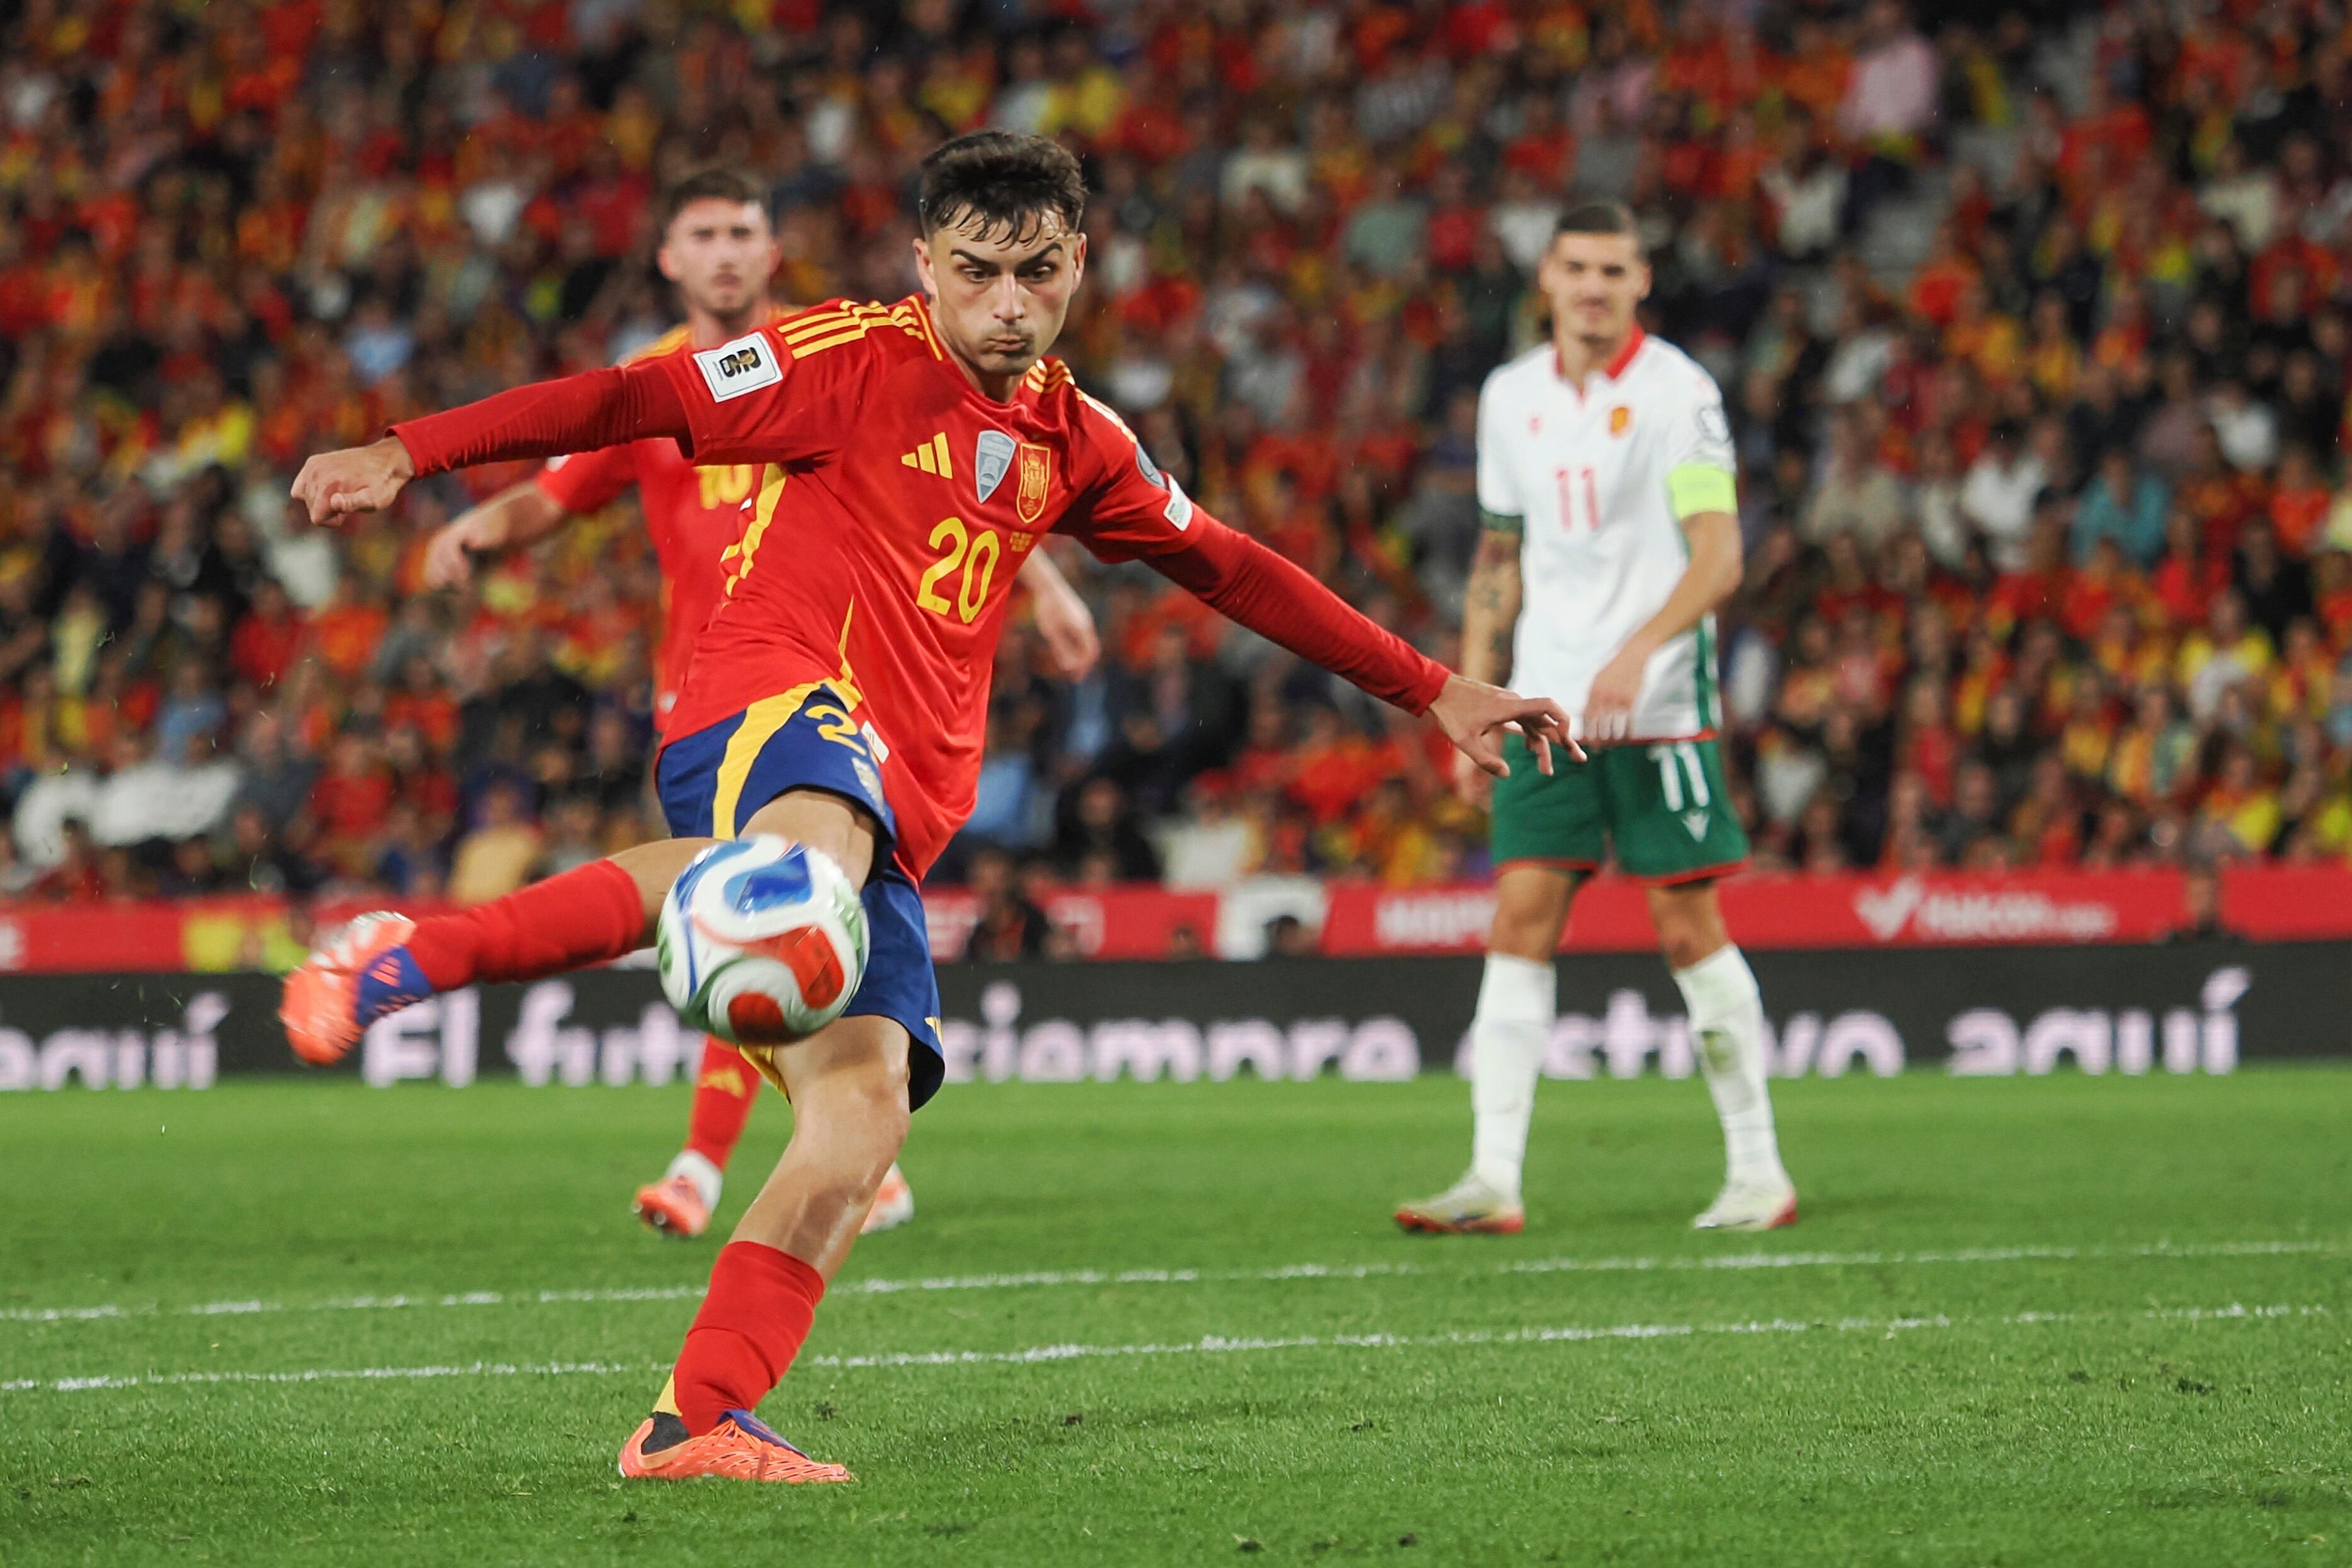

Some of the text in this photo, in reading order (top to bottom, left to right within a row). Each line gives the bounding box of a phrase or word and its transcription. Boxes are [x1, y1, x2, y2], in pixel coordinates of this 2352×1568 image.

[1555, 467, 1601, 533] 11
[916, 516, 1000, 624] 20
[804, 703, 869, 756] 2
[1645, 740, 1711, 812] 11
[363, 982, 480, 1088] El
[1946, 965, 2252, 1076] aquí
